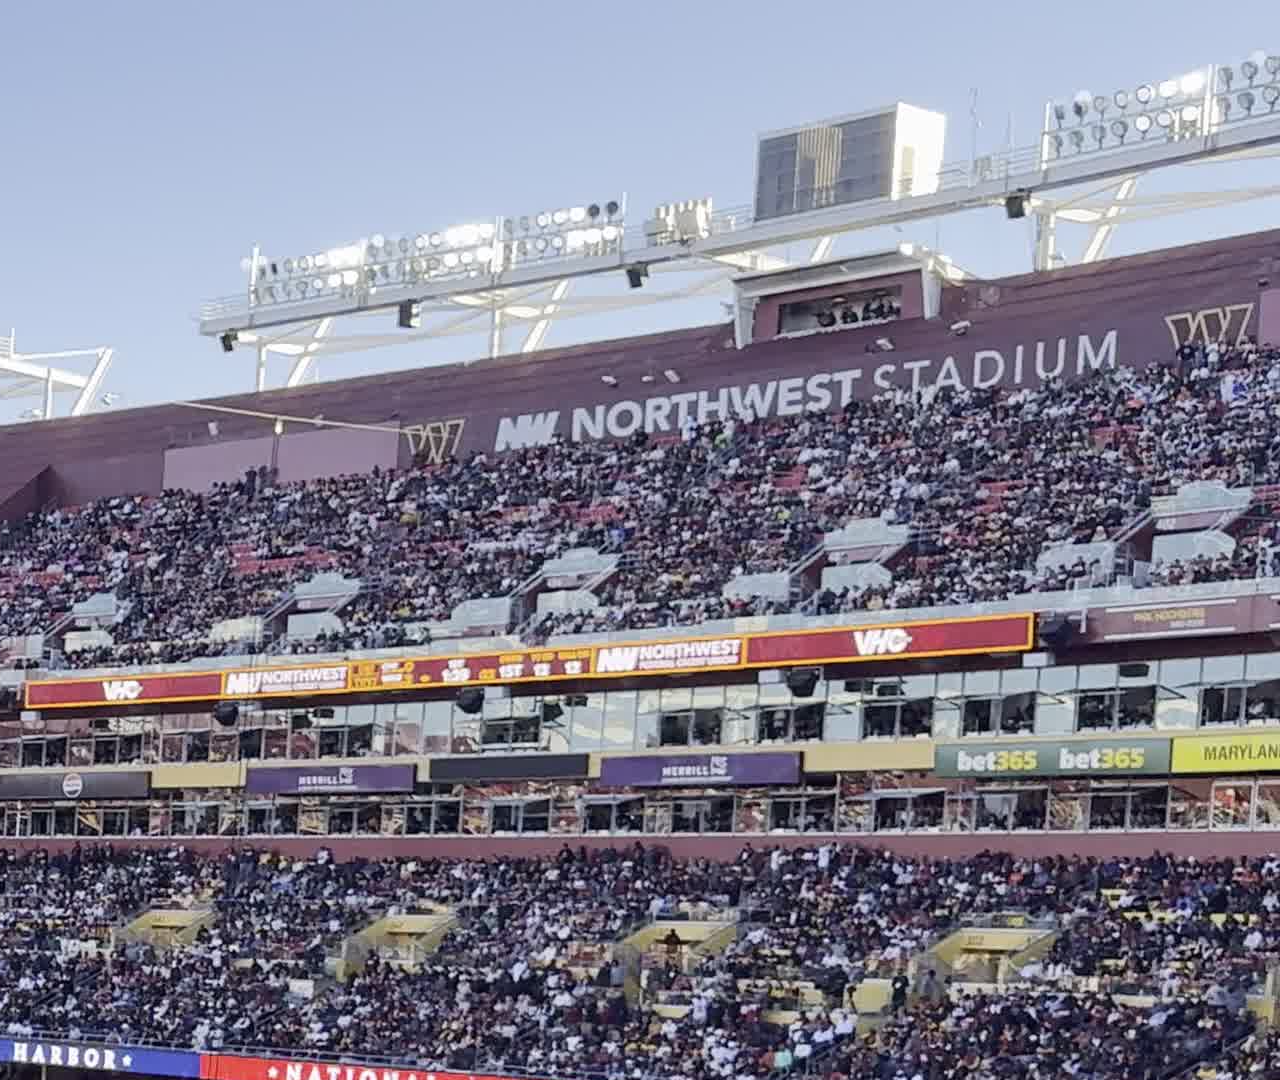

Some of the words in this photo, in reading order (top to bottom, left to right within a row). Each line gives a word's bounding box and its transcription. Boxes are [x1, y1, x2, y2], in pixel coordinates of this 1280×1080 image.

[571, 369, 862, 444] NORTHWEST
[873, 329, 1118, 398] STADIUM
[640, 639, 740, 660] NORTHWEST
[262, 666, 348, 684] NORTHWEST
[957, 750, 1037, 771] bet365
[1059, 748, 1145, 769] bet365
[662, 766, 708, 777] MERRILL
[13, 1042, 117, 1069] HARBOR
